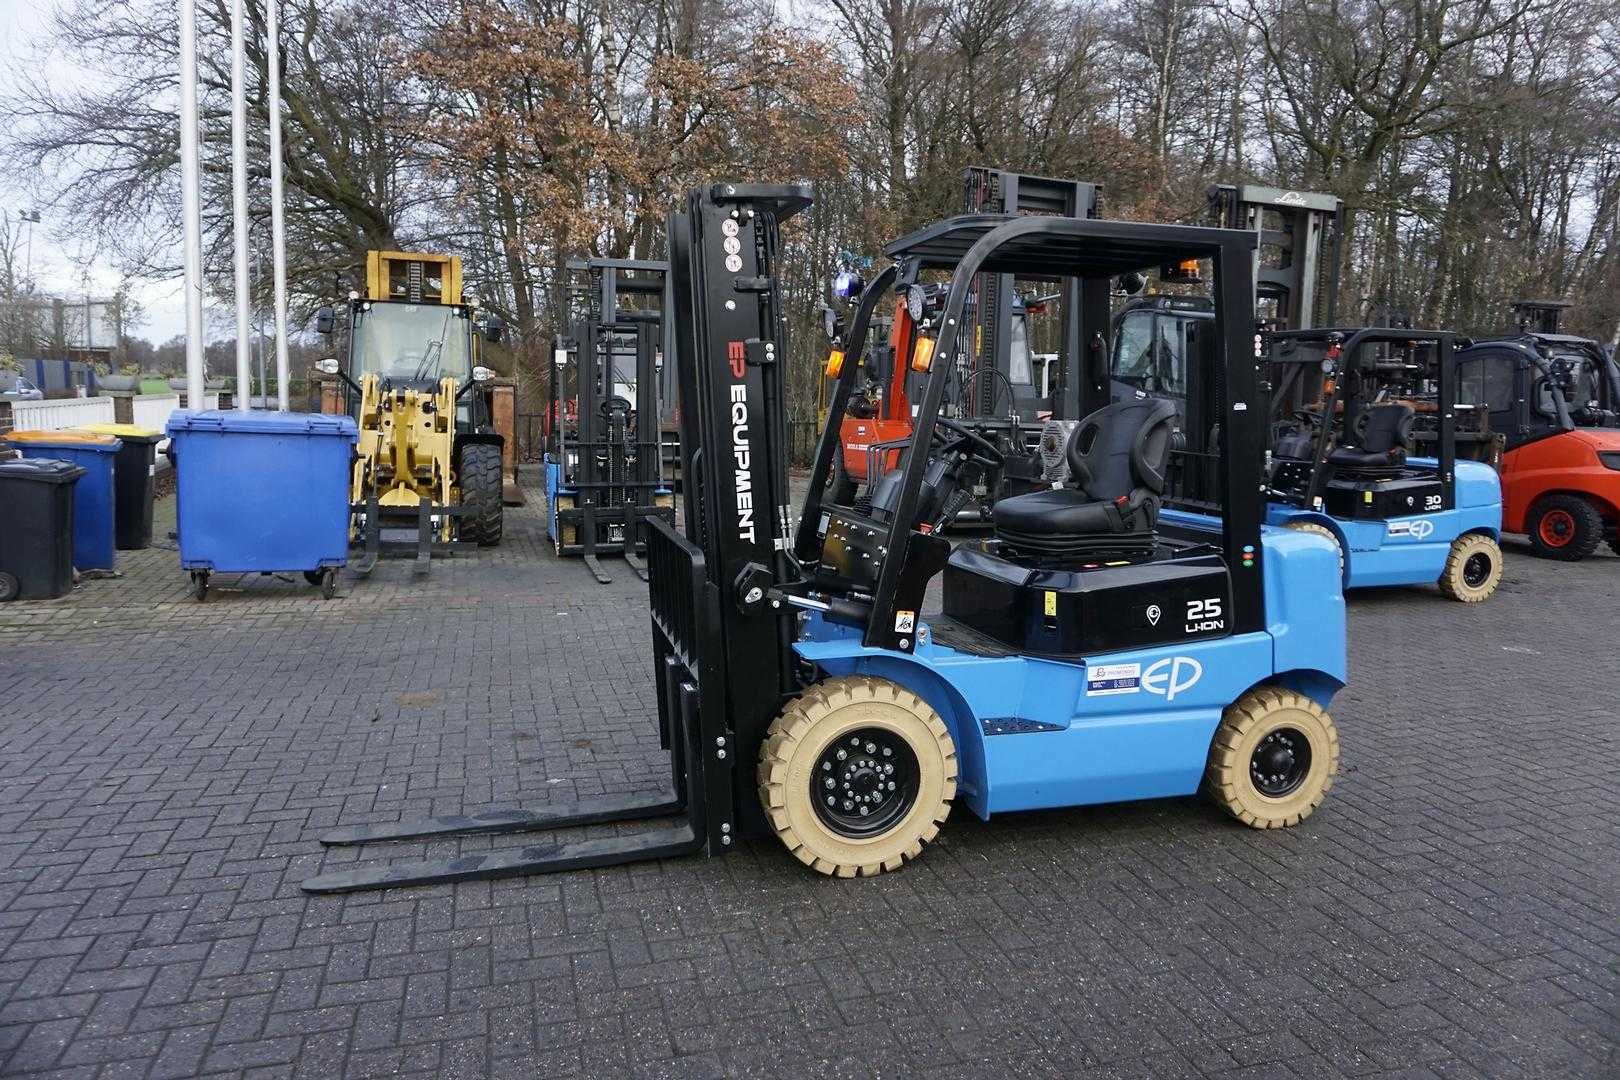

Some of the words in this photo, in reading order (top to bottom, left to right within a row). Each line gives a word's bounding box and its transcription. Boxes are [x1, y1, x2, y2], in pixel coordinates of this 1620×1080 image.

[728, 341, 746, 379] EP
[730, 384, 756, 545] EQUIPMENT
[1425, 495, 1442, 505] 30
[1187, 598, 1222, 620] 25
[1141, 656, 1203, 701] EP
